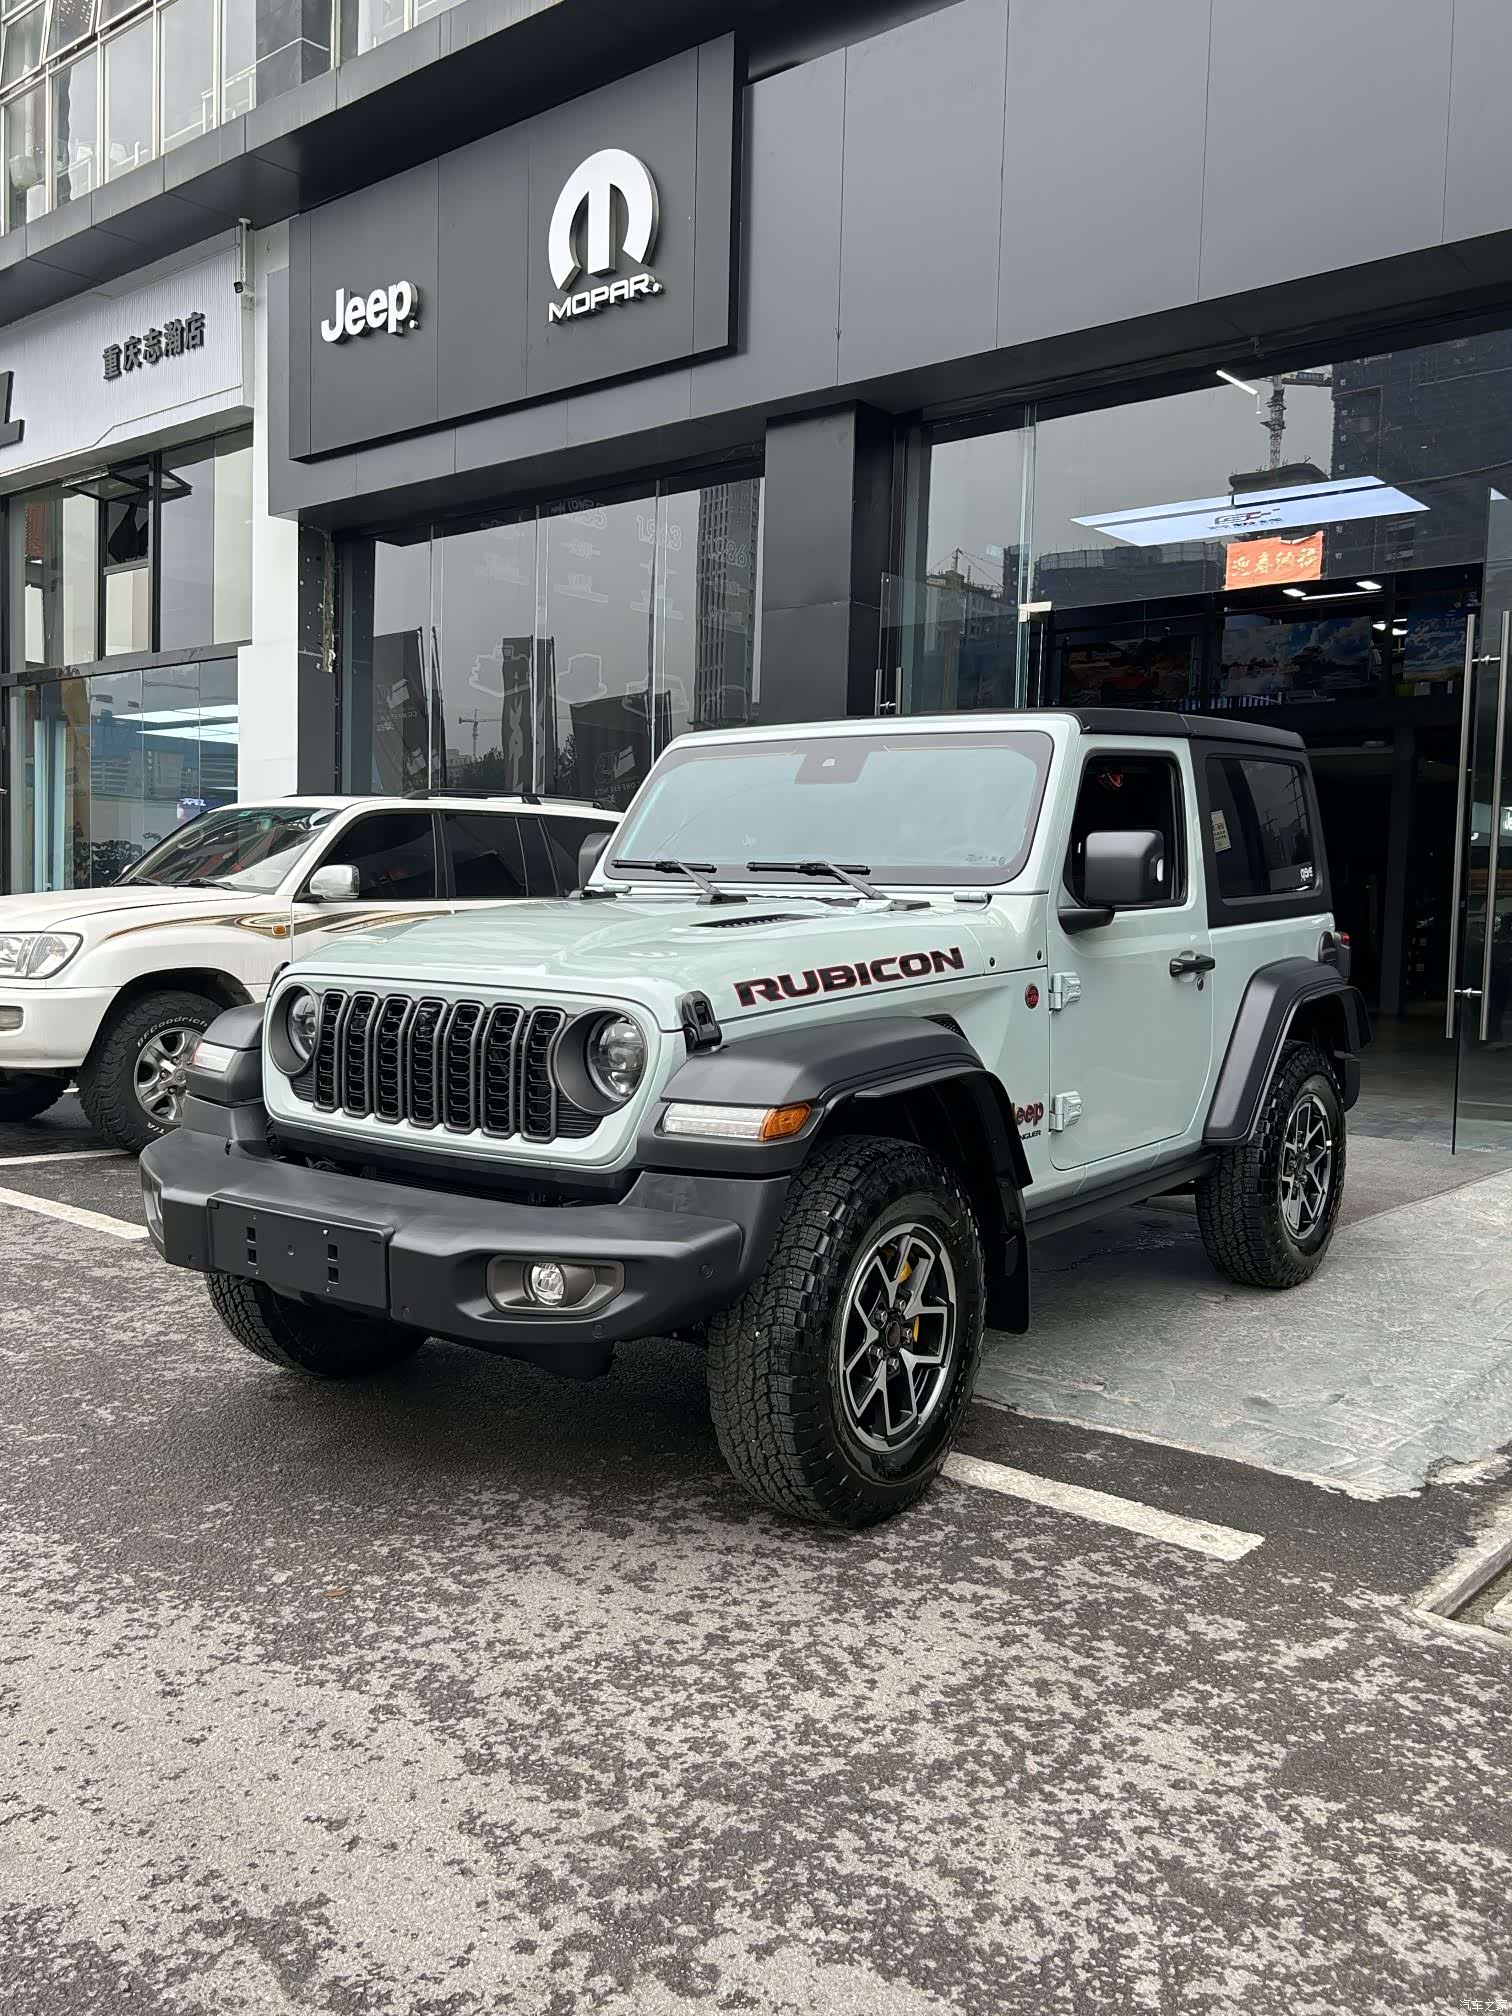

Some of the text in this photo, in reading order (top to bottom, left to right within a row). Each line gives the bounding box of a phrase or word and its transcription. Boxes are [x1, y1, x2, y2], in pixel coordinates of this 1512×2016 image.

[103, 312, 205, 381] 重庆志瀚店
[733, 947, 965, 1007] RUBICON
[137, 1016, 208, 1048] BFGoodrich
